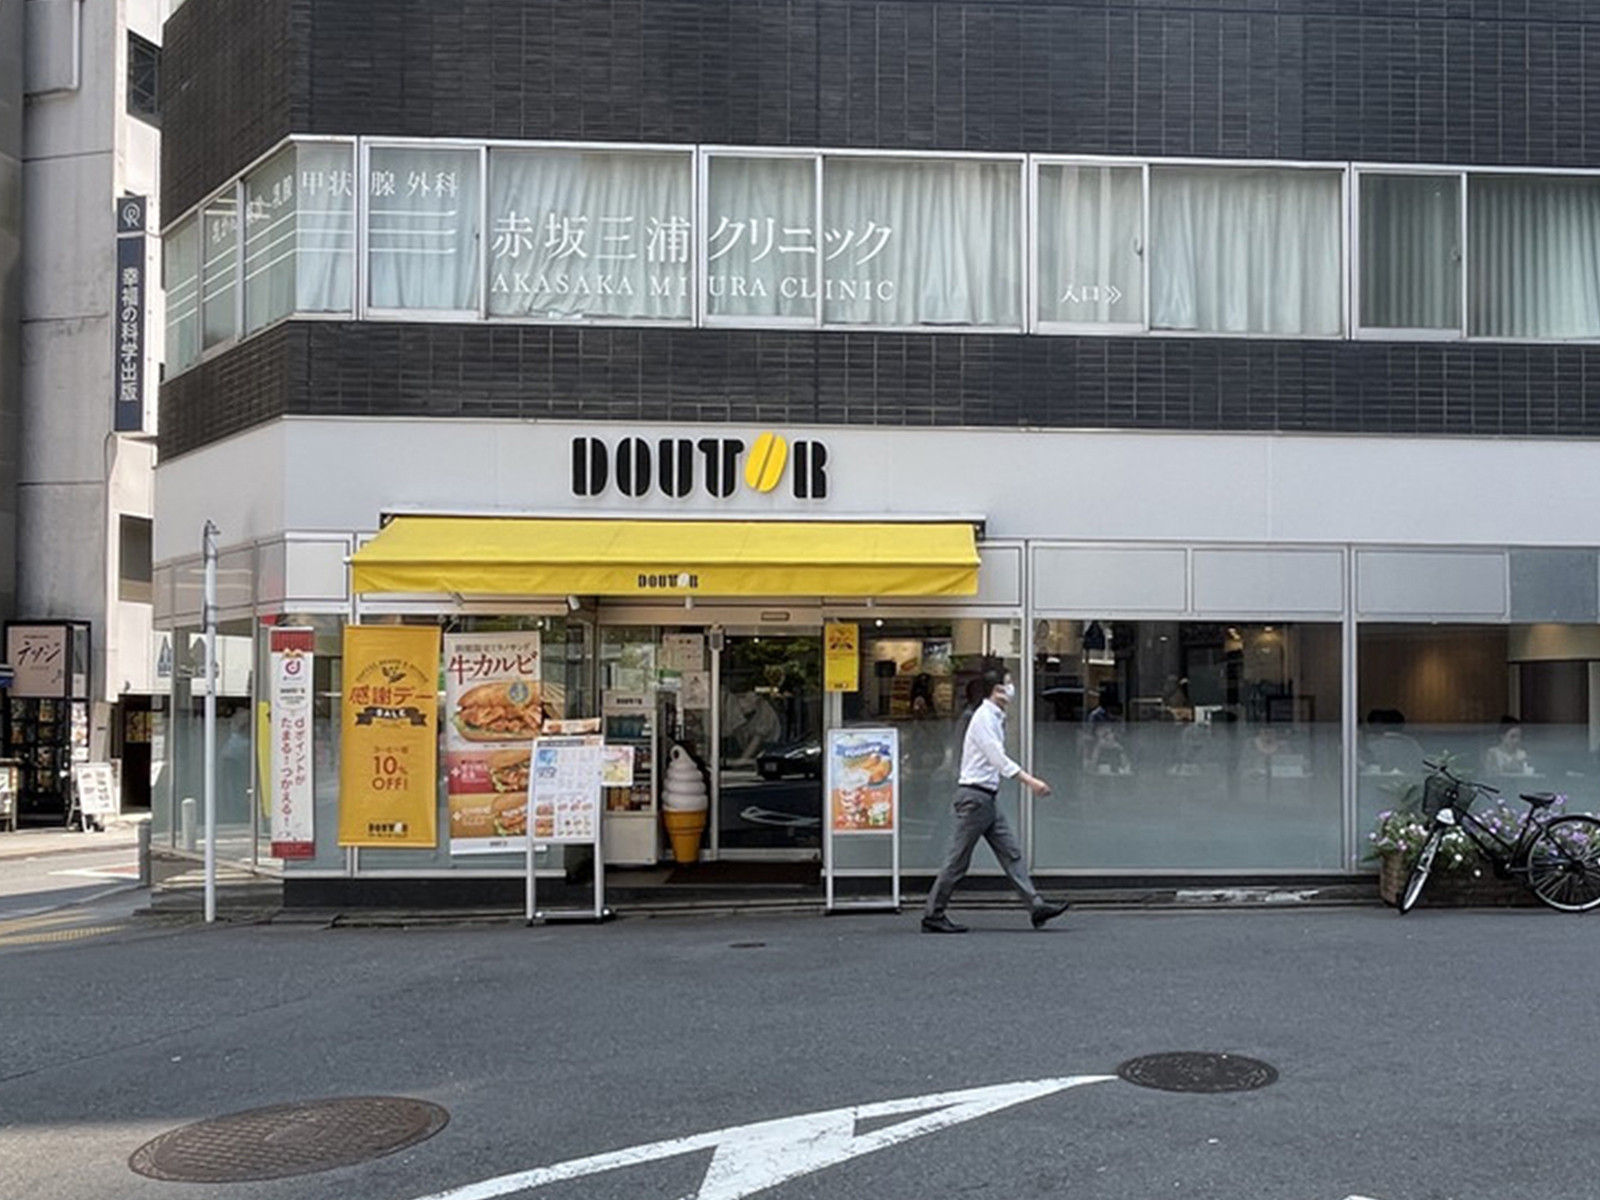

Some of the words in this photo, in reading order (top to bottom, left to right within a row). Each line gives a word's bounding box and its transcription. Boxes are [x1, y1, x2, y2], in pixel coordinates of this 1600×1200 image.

[491, 211, 893, 265] 赤坂三浦クリニック
[491, 274, 635, 299] AKASAKA
[651, 277, 768, 300] MIURA
[781, 278, 895, 302] CLINIC
[1061, 284, 1099, 303] 入口
[572, 431, 829, 499] DOUTOR
[638, 572, 699, 588] DOUTOR
[447, 650, 538, 685] 牛カルビ
[349, 685, 433, 706] 感謝デー
